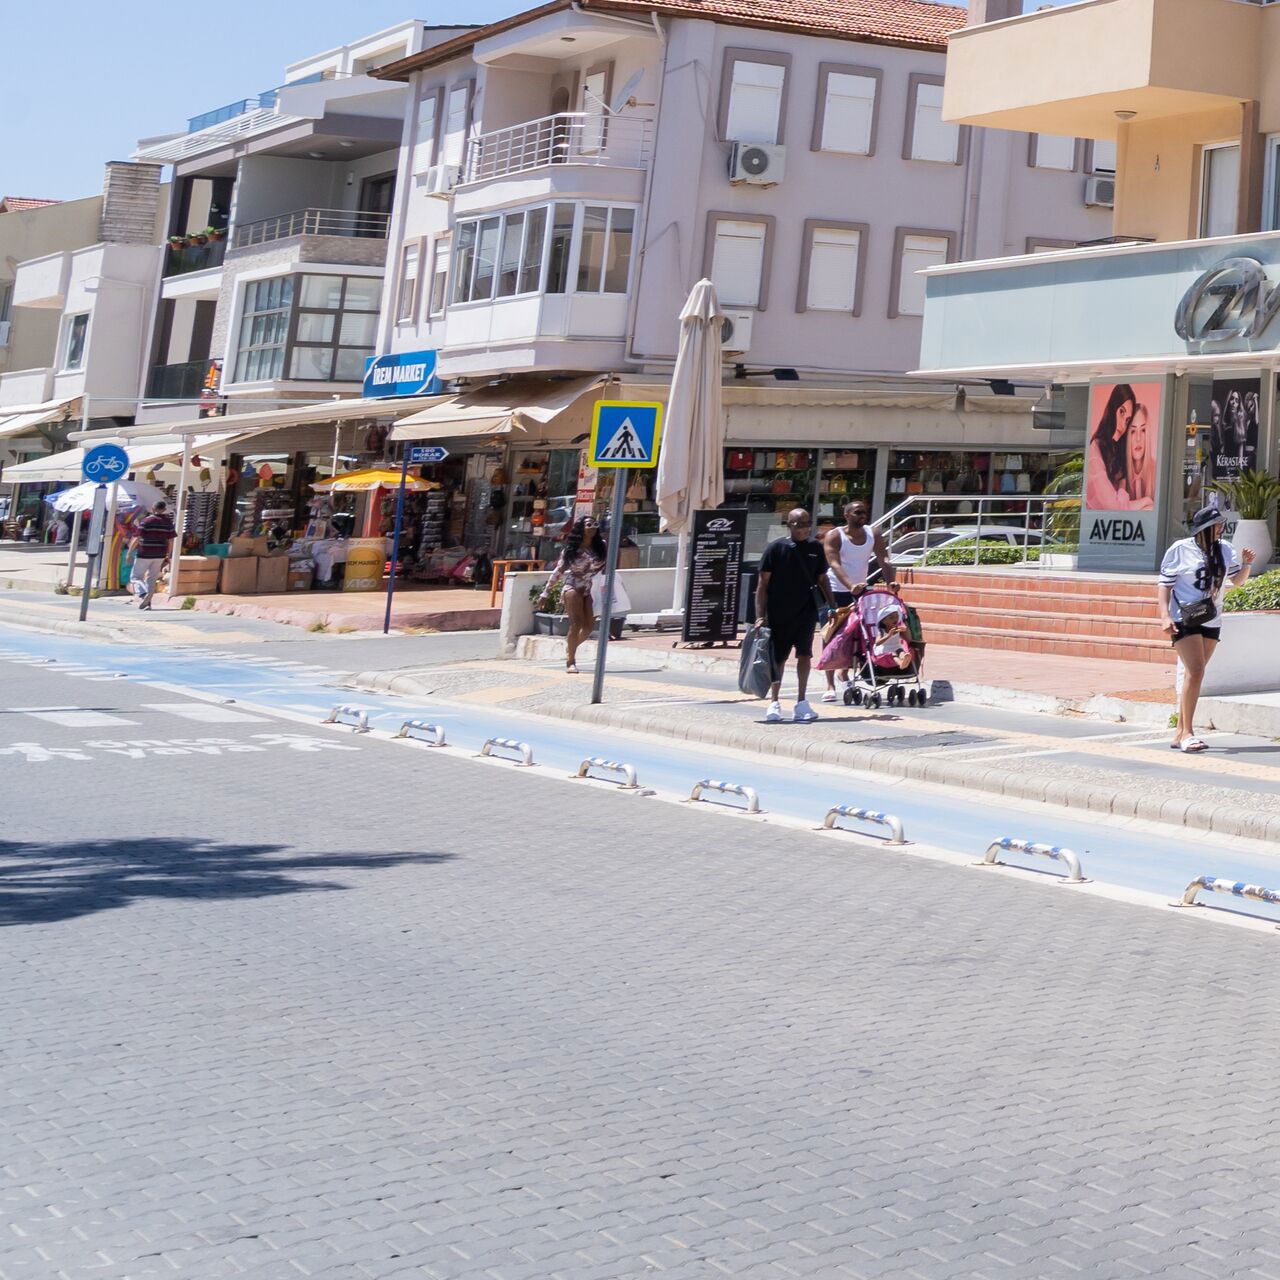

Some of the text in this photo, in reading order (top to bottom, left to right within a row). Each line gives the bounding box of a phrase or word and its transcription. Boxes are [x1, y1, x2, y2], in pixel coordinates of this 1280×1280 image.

[393, 363, 427, 383] MARKET
[1216, 454, 1249, 467] KÉRASTASE
[1089, 519, 1146, 541] AVEDA
